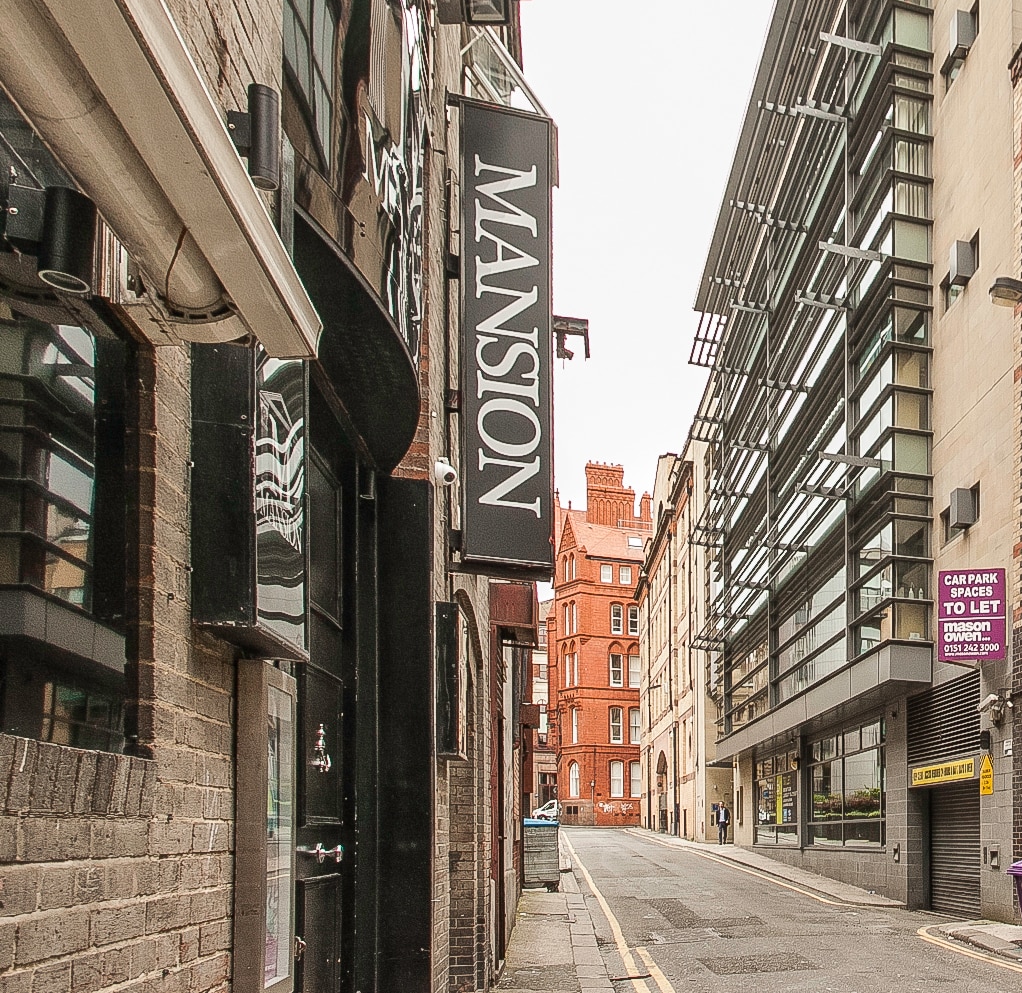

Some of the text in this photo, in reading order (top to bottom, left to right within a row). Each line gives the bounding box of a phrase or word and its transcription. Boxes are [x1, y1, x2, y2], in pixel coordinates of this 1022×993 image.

[474, 153, 542, 518] MANSION
[944, 572, 998, 586] CAR PARK
[950, 585, 993, 598] SPACES
[943, 599, 1001, 615] TO LET
[943, 621, 991, 632] mason
[944, 642, 1000, 652] 0151 242 3000
